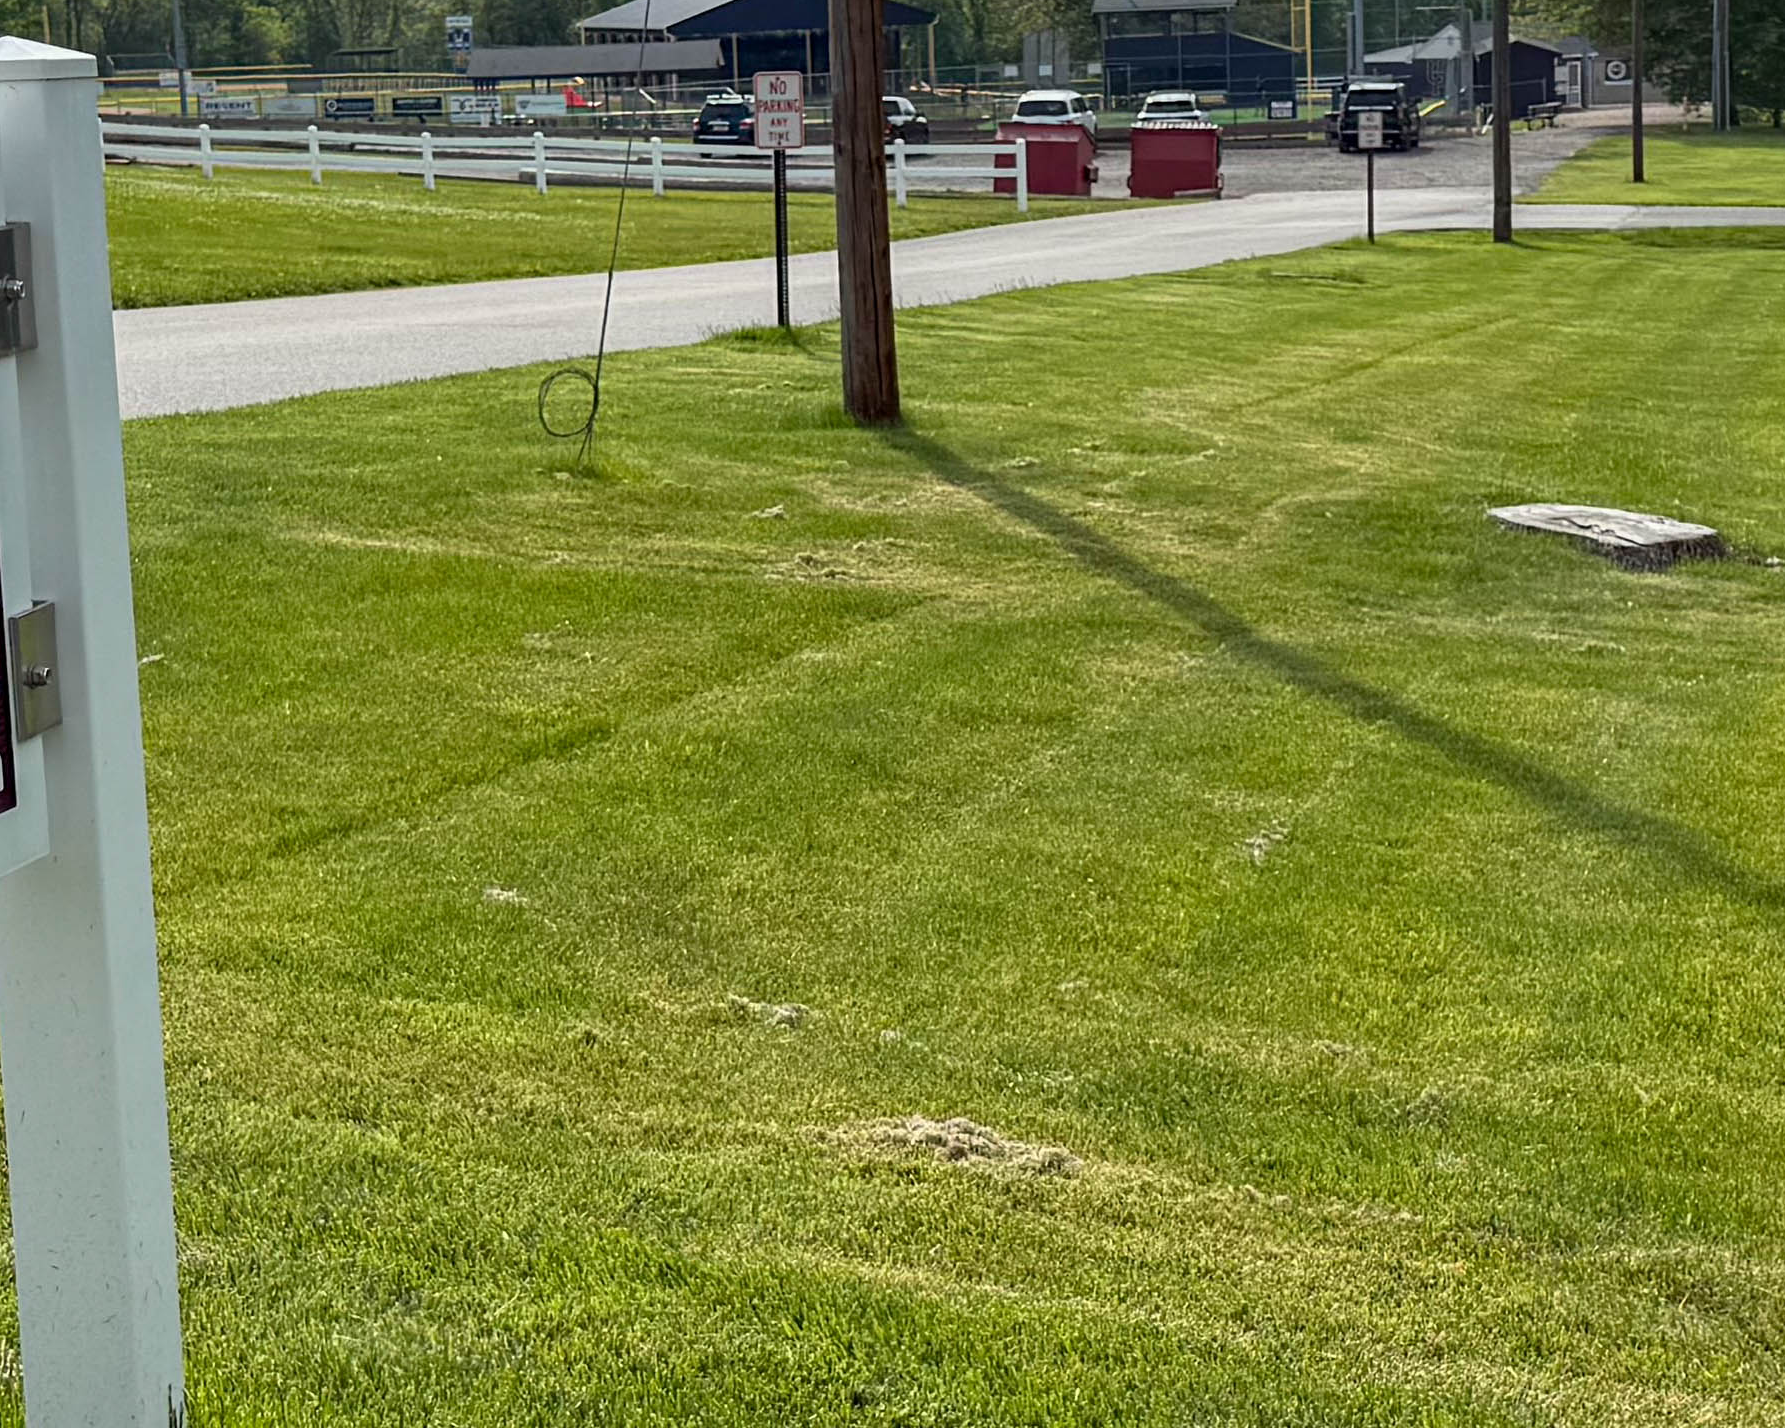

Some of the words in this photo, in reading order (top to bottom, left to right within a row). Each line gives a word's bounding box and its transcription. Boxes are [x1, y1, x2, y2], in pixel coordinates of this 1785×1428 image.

[769, 80, 787, 95] NO
[758, 99, 801, 113] PARKING
[770, 117, 788, 127] ANY
[768, 131, 790, 142] TIME
